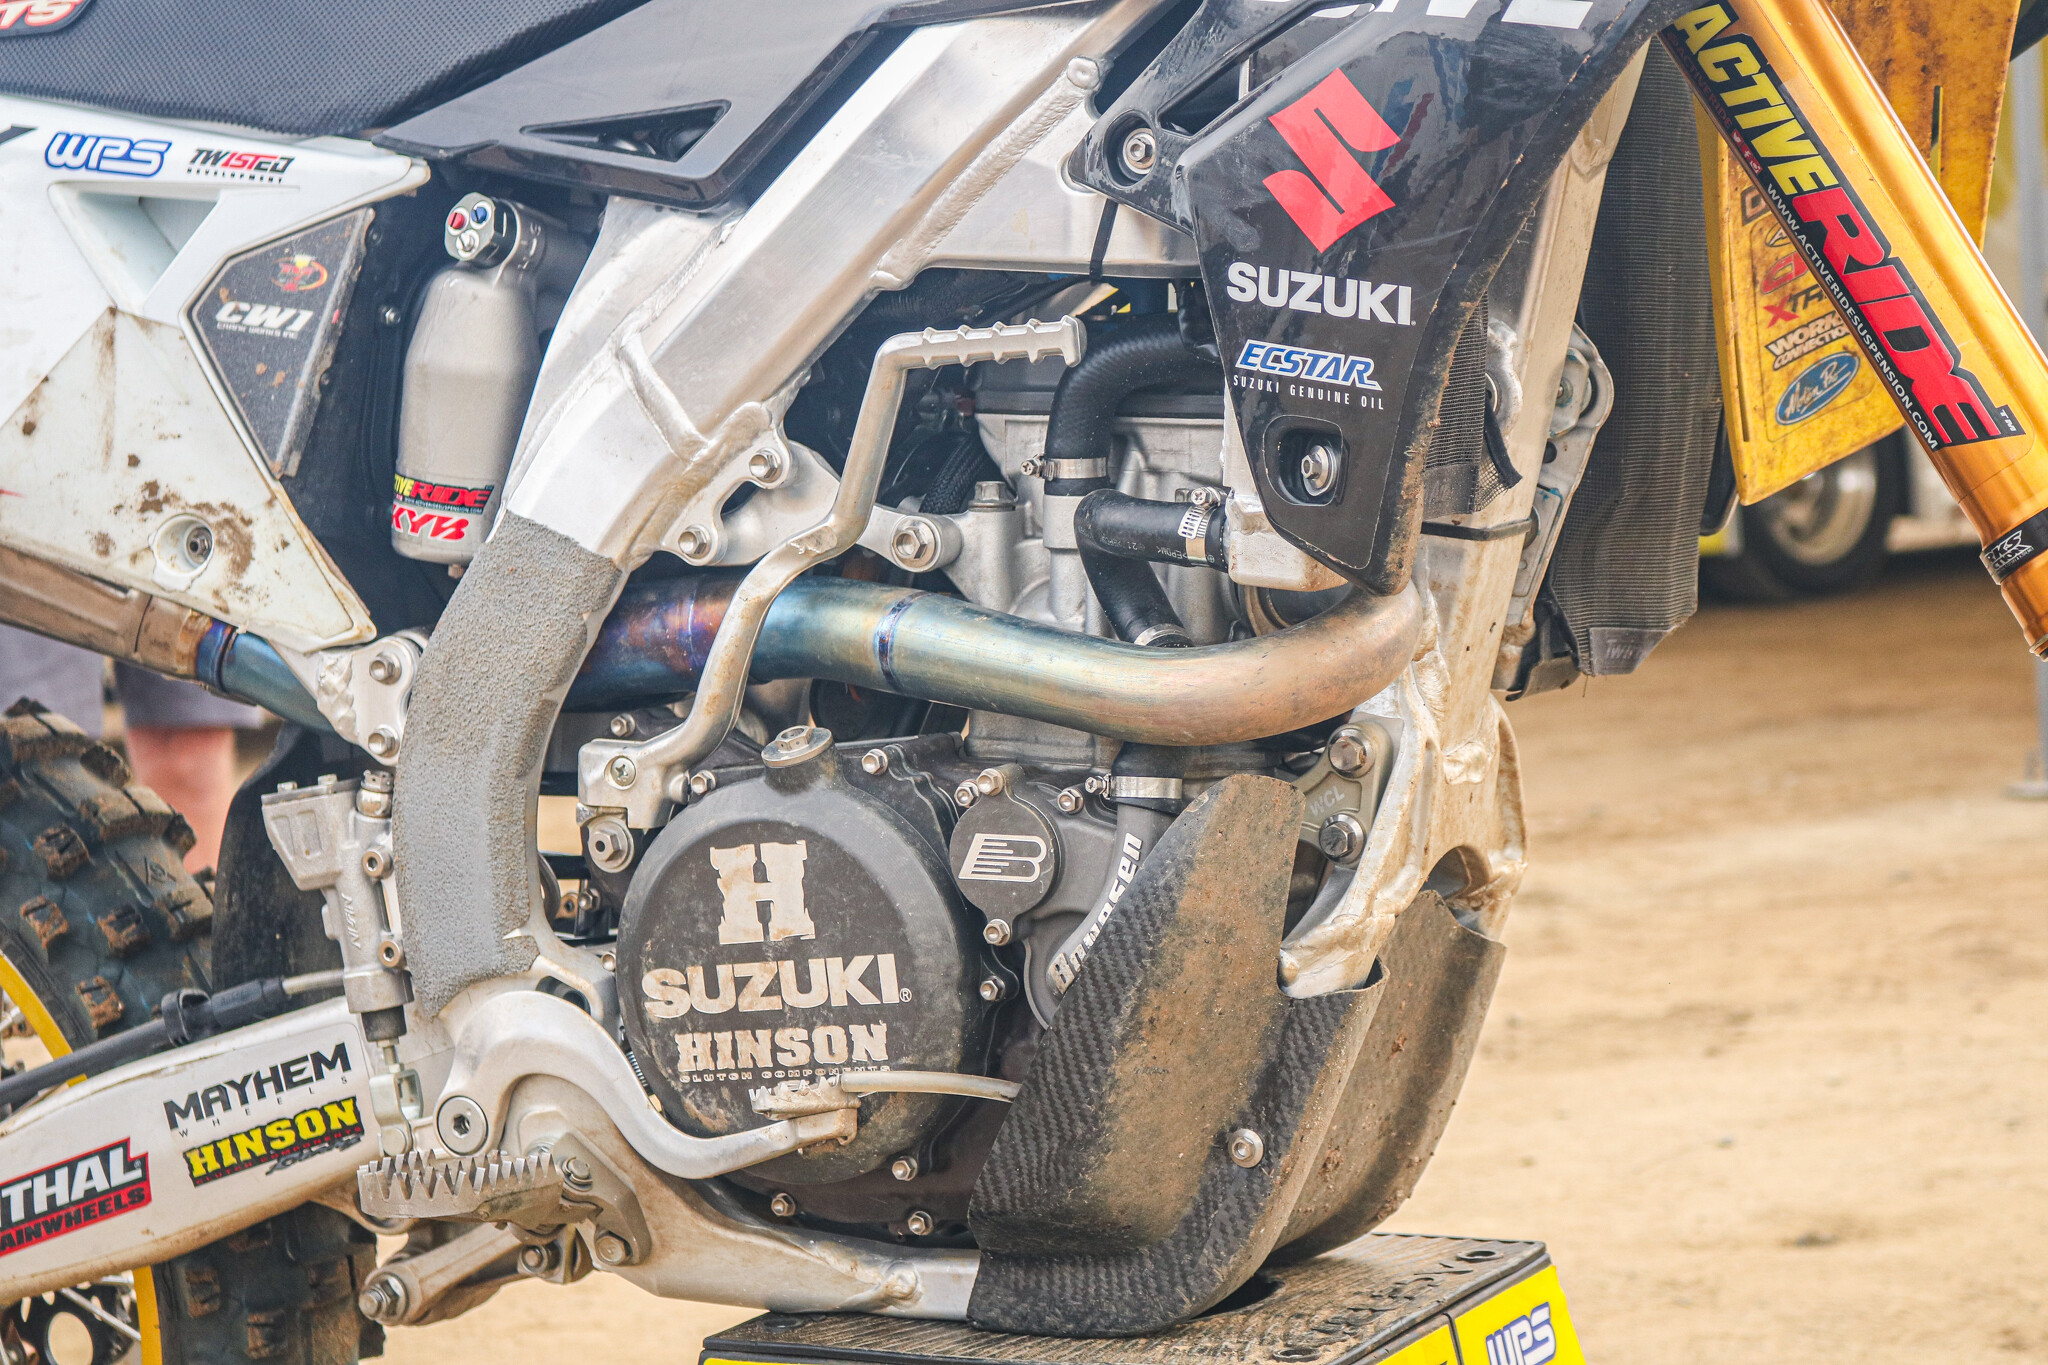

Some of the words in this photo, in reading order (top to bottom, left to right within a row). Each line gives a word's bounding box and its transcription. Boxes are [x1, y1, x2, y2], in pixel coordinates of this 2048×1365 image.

[45, 132, 172, 178] WPS
[1226, 261, 1412, 326] SUZUKI
[1767, 183, 1938, 450] WWW.ACTIVERIDESUSPENSION.COM
[1233, 374, 1280, 393] SUZUKI
[1290, 384, 1350, 405] GENUINE
[1361, 395, 1384, 410] OIL
[1235, 339, 1383, 391] ECSTAR
[392, 504, 469, 541] KYB
[1310, 786, 1345, 816] WCL
[709, 839, 816, 945] H
[641, 953, 900, 1019] SUZUKI
[674, 1020, 889, 1072] HINSON
[163, 1042, 352, 1131] MAYHEM
[186, 1098, 361, 1178] HINSON
[0, 1147, 143, 1224] THAL
[1485, 1301, 1557, 1365] WPS
